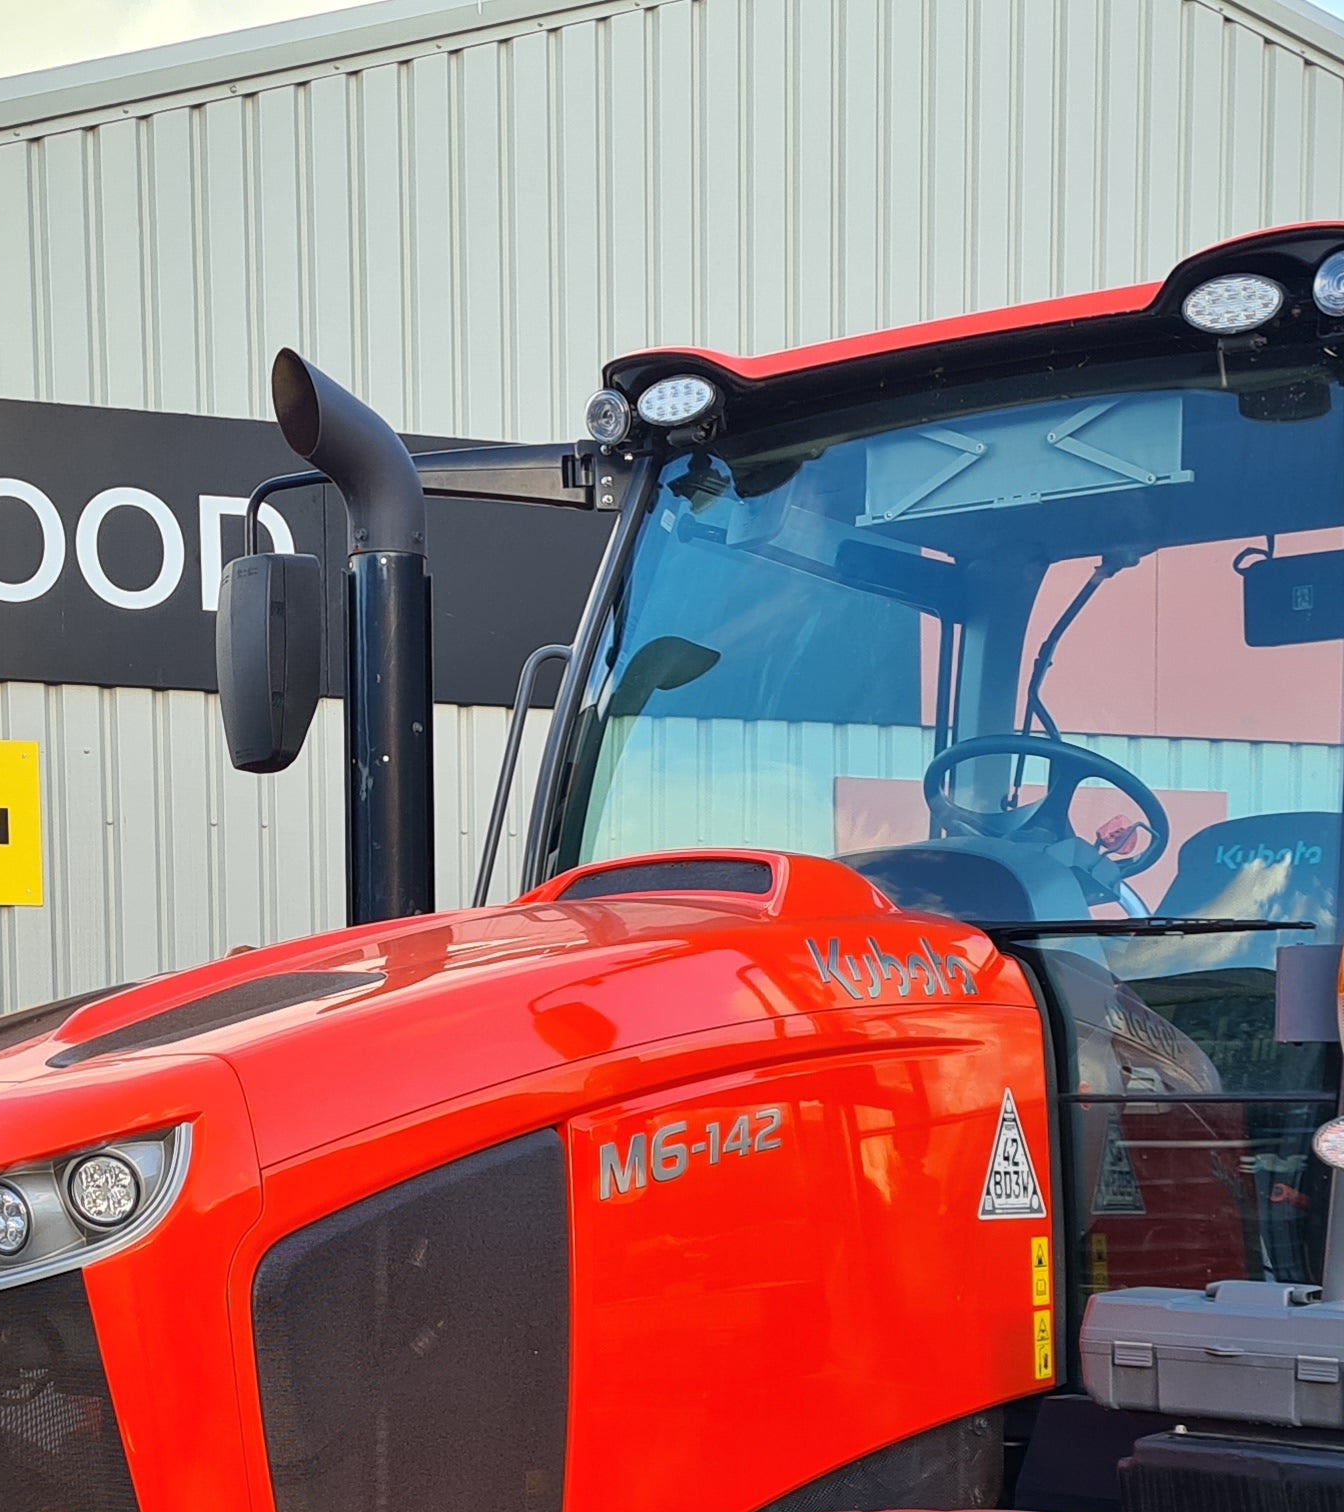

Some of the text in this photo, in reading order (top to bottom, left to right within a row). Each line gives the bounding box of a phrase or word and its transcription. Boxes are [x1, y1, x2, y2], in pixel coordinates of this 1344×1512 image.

[1216, 840, 1323, 870] Kubota
[806, 937, 978, 999] Kubota
[599, 1108, 784, 1200] M6-142
[1002, 1137, 1020, 1167] 42
[993, 1170, 1030, 1199] BD3W
